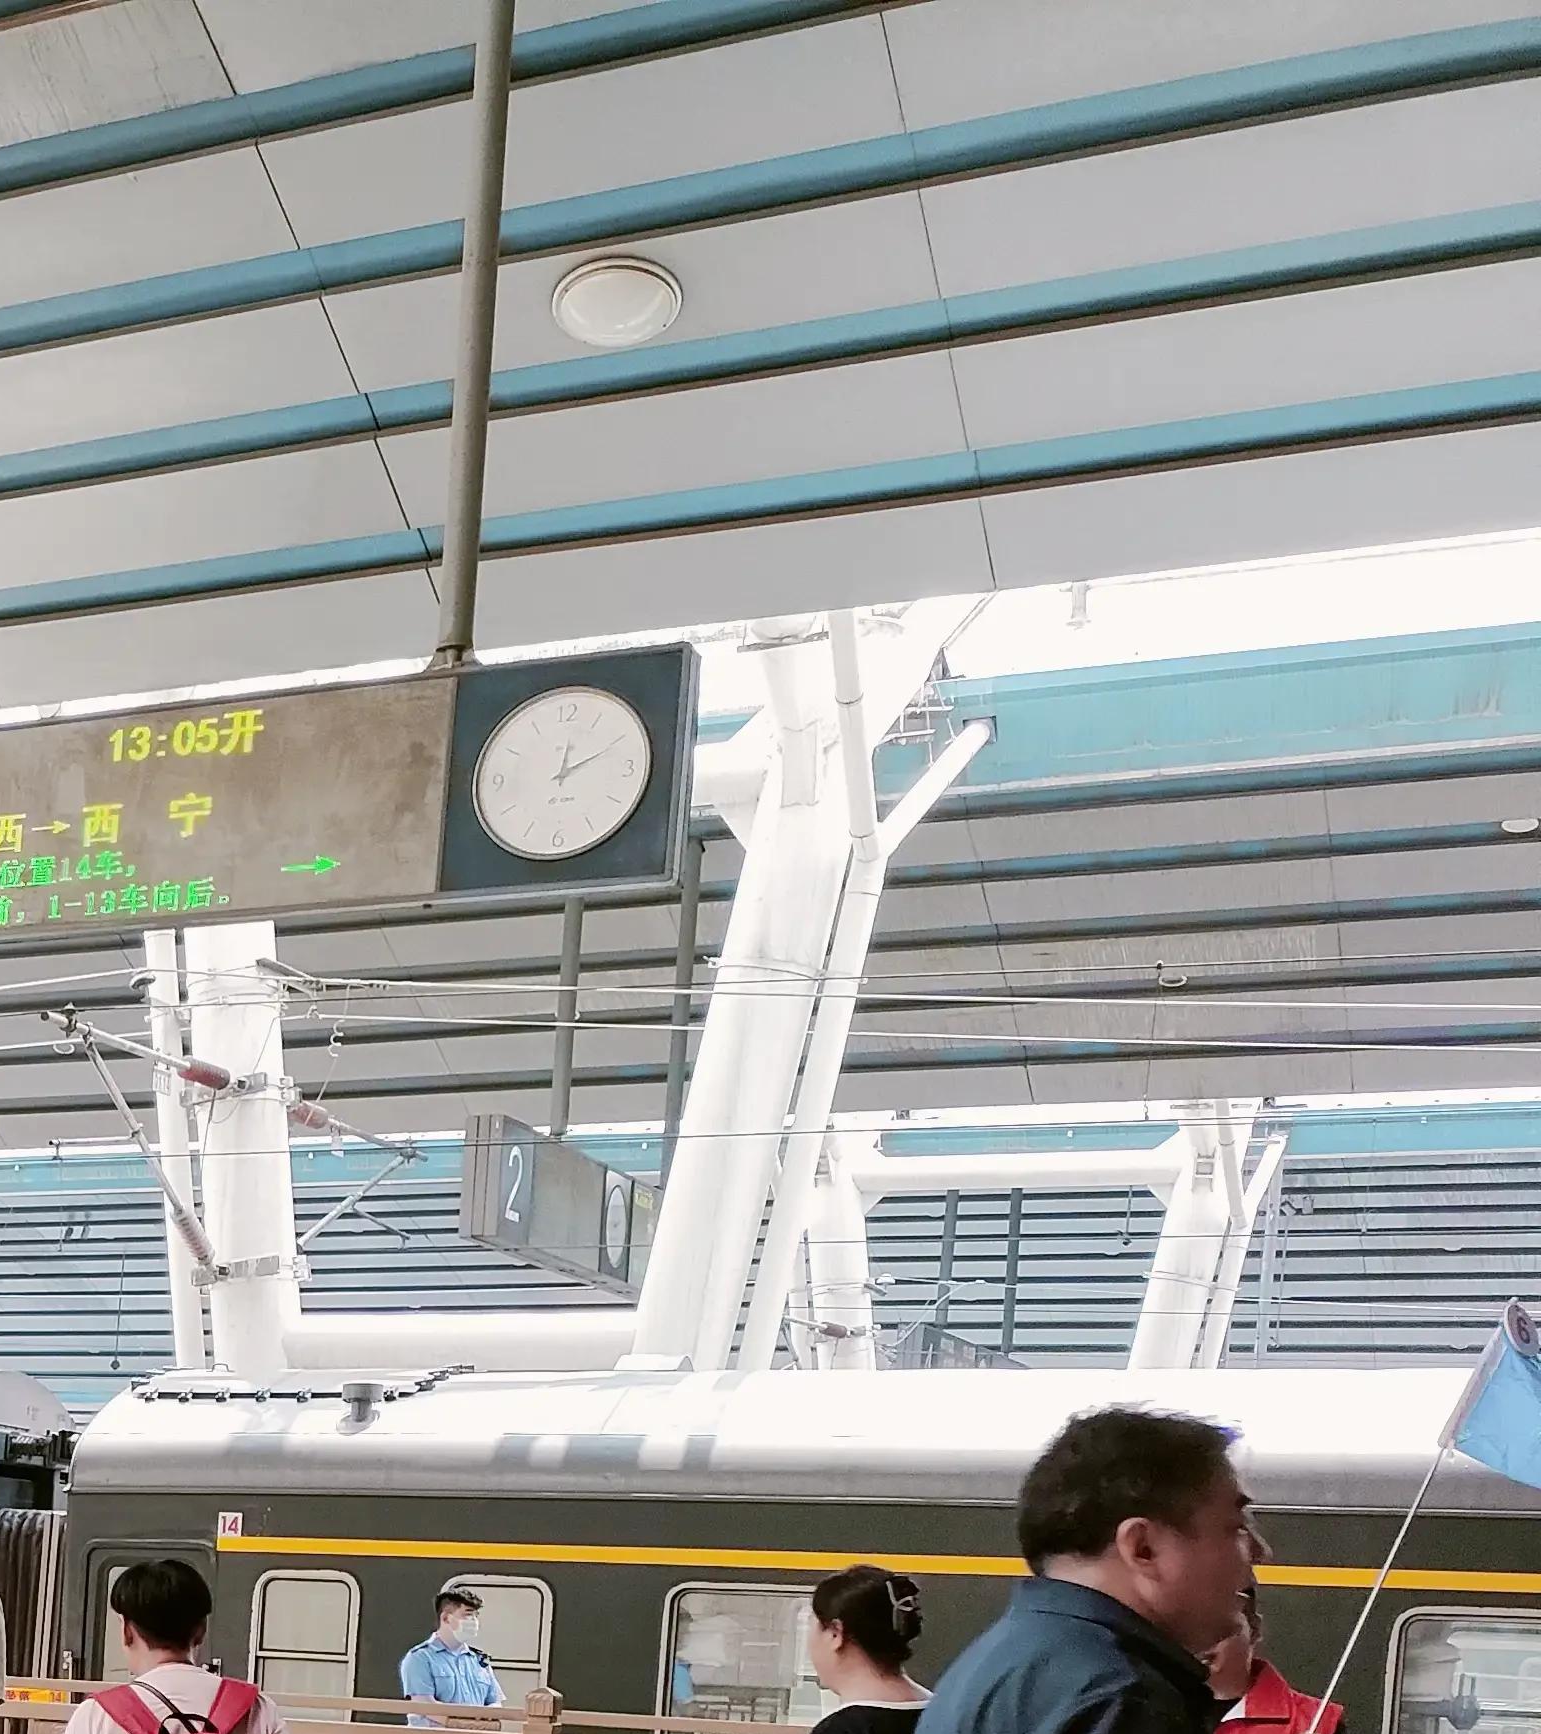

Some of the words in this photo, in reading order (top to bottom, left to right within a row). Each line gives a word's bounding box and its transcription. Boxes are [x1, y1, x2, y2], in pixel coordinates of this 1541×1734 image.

[556, 703, 578, 723] 12
[109, 709, 264, 762] 13:05开
[492, 774, 505, 793] 9
[621, 759, 635, 778] 3
[551, 828, 566, 848] 6
[504, 1145, 524, 1223] 2
[219, 1515, 240, 1535] 14
